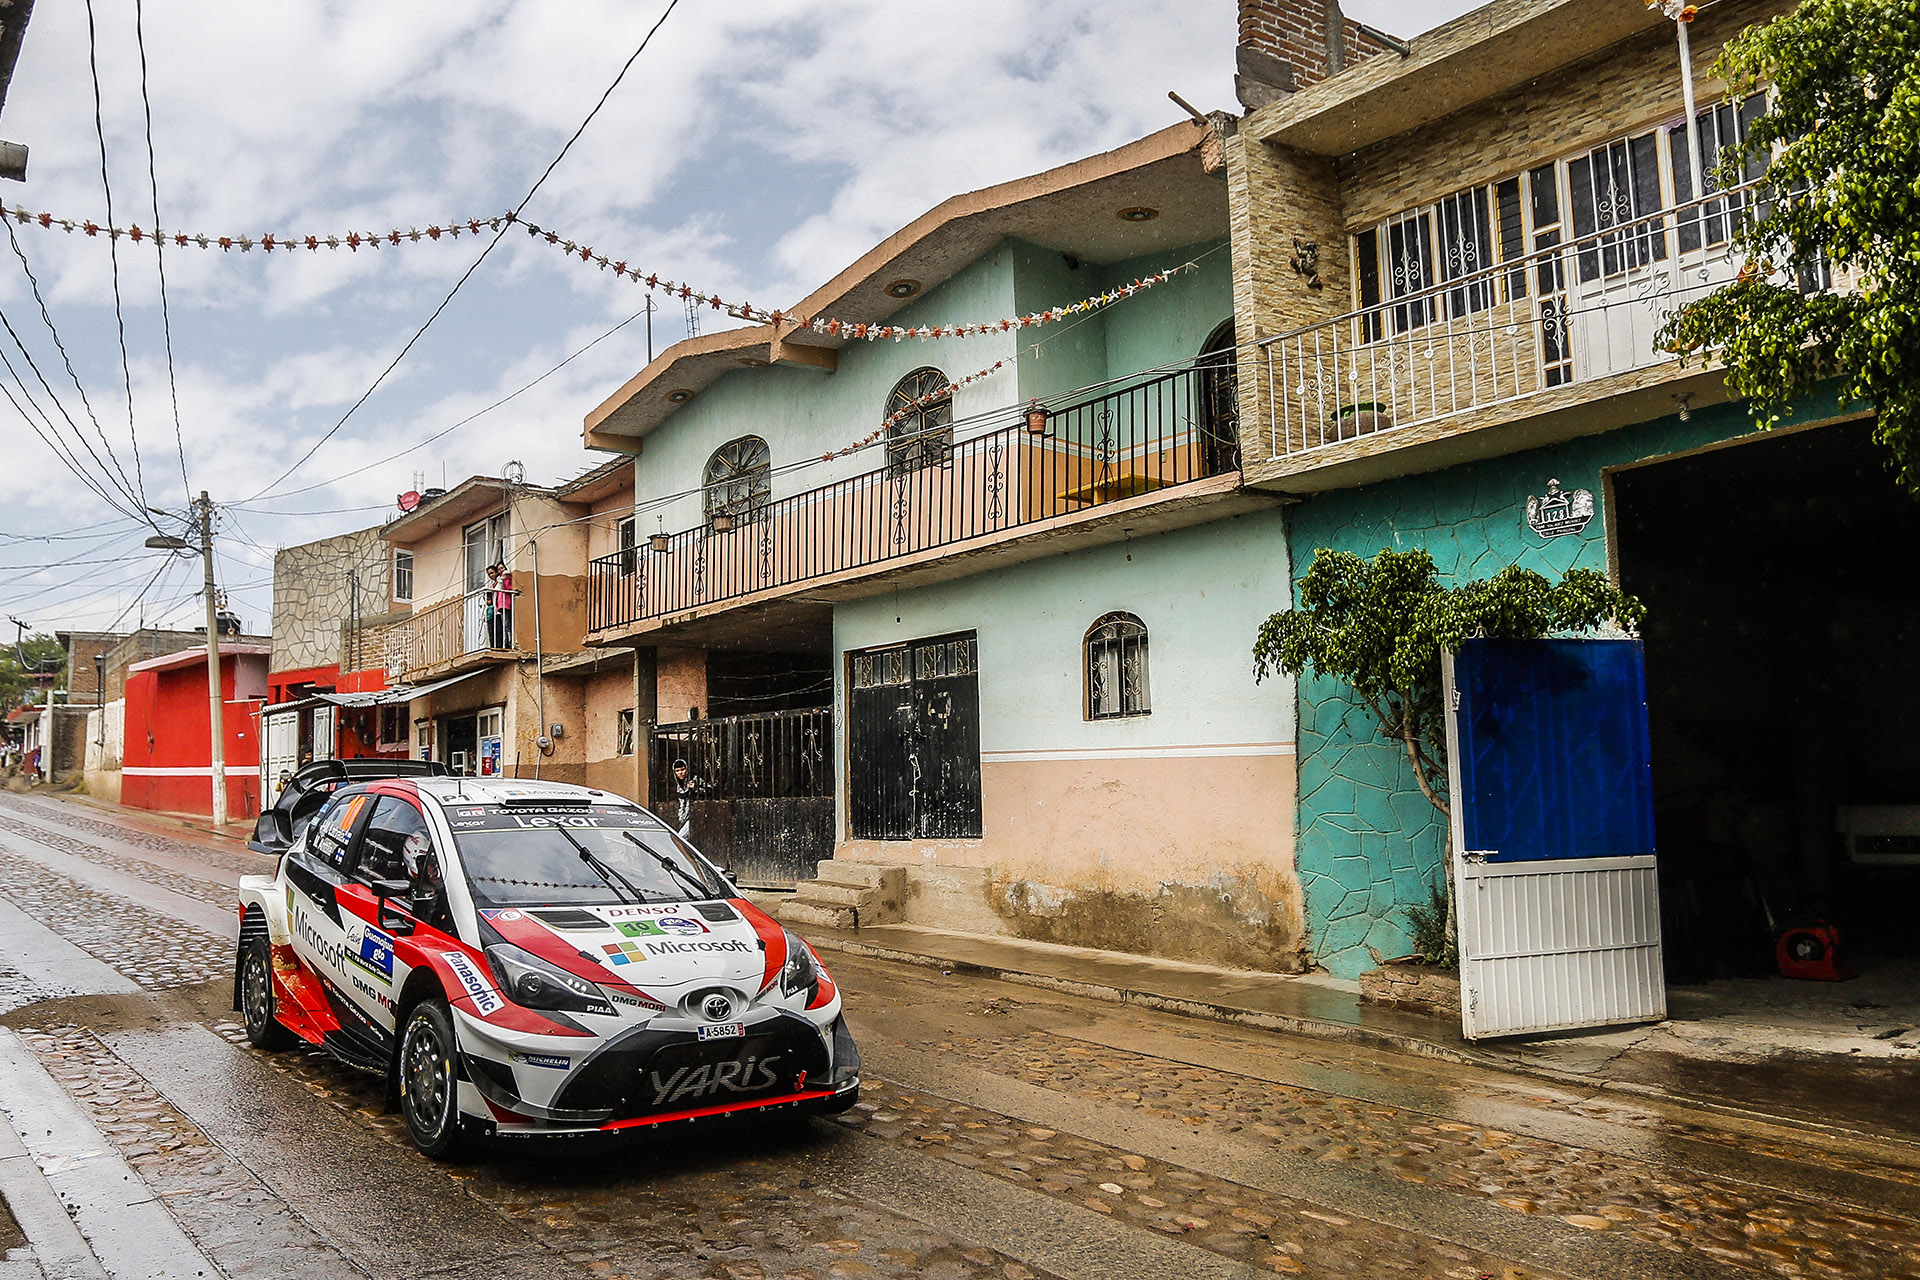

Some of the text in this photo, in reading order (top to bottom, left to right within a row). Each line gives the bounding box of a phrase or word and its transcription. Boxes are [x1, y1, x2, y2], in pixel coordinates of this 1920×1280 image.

[1546, 509, 1564, 521] 128
[526, 789, 582, 797] Microsoft
[458, 808, 485, 817] GR
[488, 807, 545, 815] TOYOTA
[546, 807, 595, 815] GAZOO
[449, 819, 486, 828] Lexar
[513, 815, 600, 828] Lexar
[608, 906, 678, 917] DENSO
[623, 922, 650, 932] 10
[295, 905, 348, 977] Microsoft
[645, 940, 752, 956] Microsoft
[352, 975, 376, 1000] DMG
[445, 952, 496, 1012] Panasonic
[586, 1004, 613, 1014] PIAA
[611, 995, 666, 1012] DMG MORI
[706, 1025, 736, 1038] A-5852
[528, 1055, 569, 1065] MICHELIN
